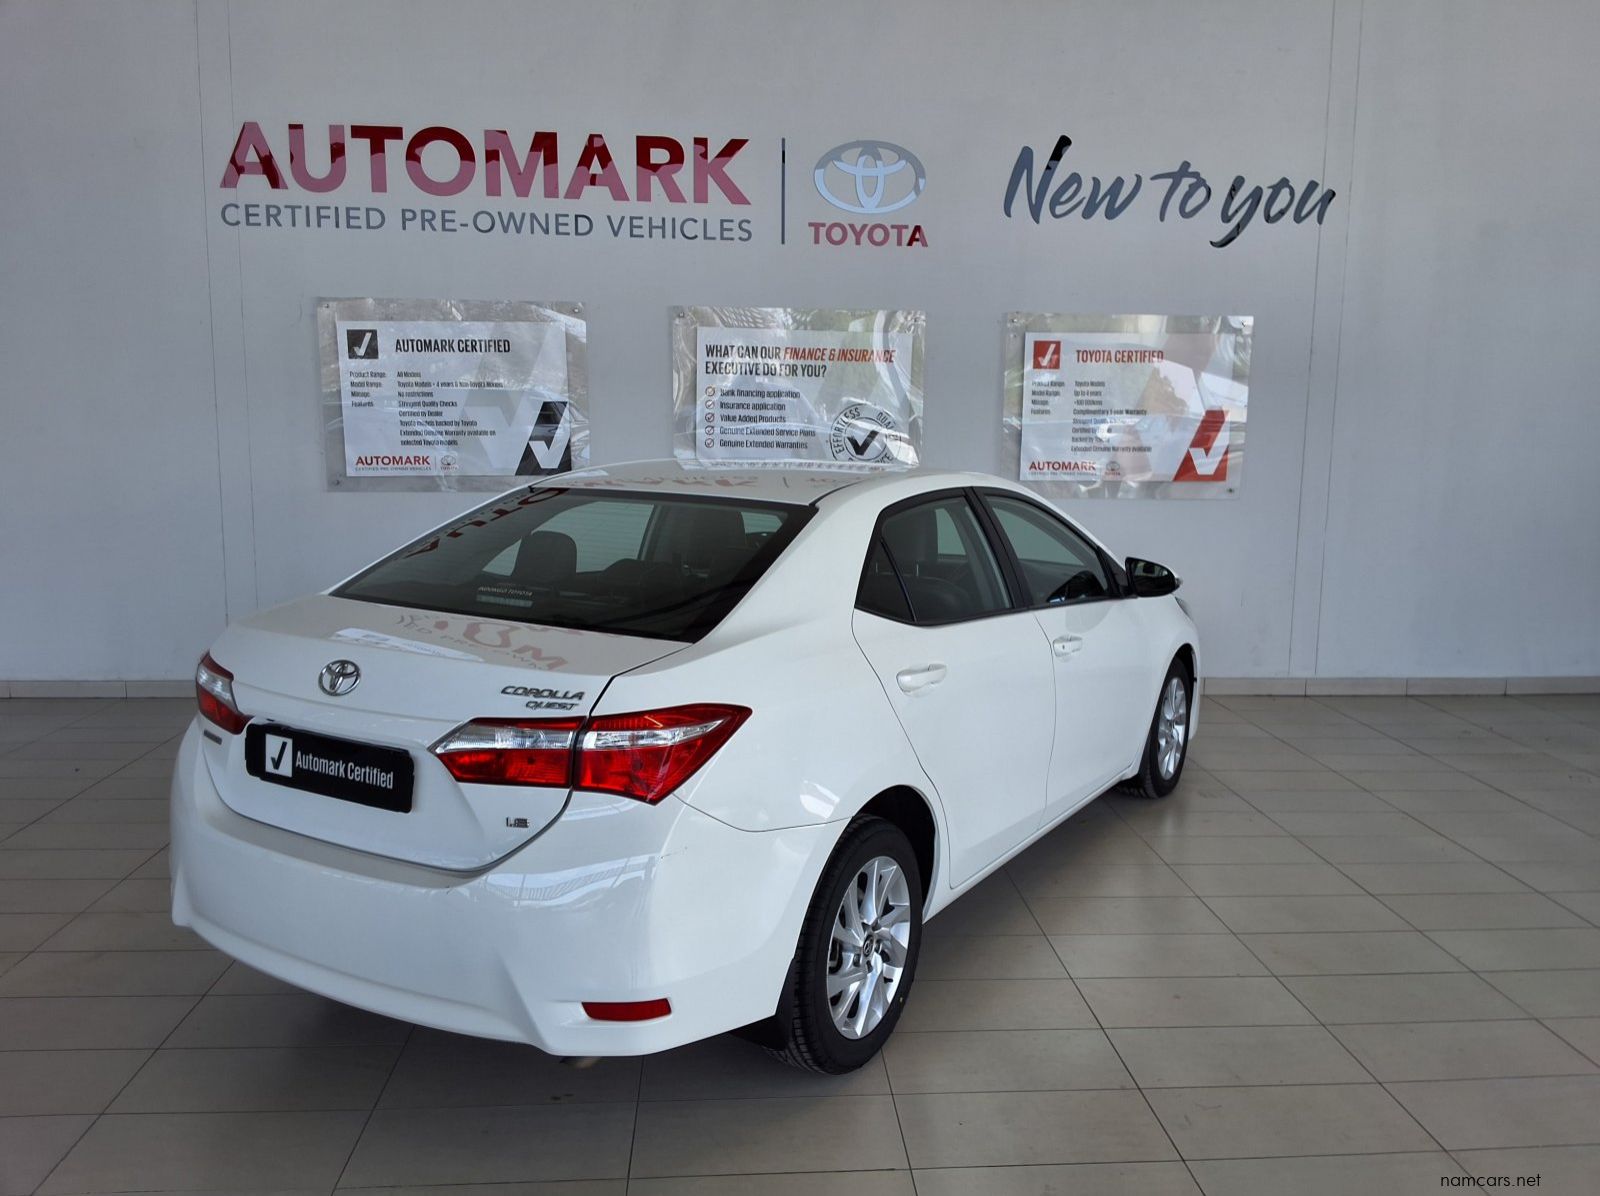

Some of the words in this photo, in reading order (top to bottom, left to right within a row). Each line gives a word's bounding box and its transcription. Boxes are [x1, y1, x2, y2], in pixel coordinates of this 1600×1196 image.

[220, 122, 751, 205] AUTOMARK
[1004, 135, 1141, 224] New
[1151, 161, 1211, 223] to
[1210, 176, 1336, 248] you
[221, 203, 386, 230] CERTIFIED
[401, 210, 593, 236] PRE-OWNED
[606, 215, 752, 241] VEHICLES
[808, 222, 928, 247] TOYOTA
[395, 339, 454, 353] AUTOMARK
[458, 339, 510, 353] CERTIFIED
[706, 344, 735, 358] WHAT
[737, 346, 758, 359] CAN
[760, 346, 781, 360] OUR
[784, 347, 827, 361] FINANCE
[837, 348, 896, 363] INSURANCE
[1076, 350, 1112, 363] TOYOTA
[1114, 350, 1164, 364] CERTIFIED
[706, 362, 760, 376] EXECUTIVE
[762, 362, 777, 376] DO
[779, 363, 798, 377] FOR
[800, 364, 827, 378] YOU?
[736, 388, 766, 398] financing
[766, 390, 800, 398] application
[720, 402, 750, 410] Insurance
[752, 402, 786, 411] application
[738, 414, 758, 422] Added
[720, 427, 744, 435] Genuine
[746, 427, 774, 436] Extended
[776, 428, 800, 436] Service
[832, 406, 860, 454] EFFORTLESS
[720, 440, 744, 448] Genuine
[746, 440, 774, 448] Extended
[776, 441, 808, 449] Warranties
[356, 456, 430, 466] AUTOMARK
[1029, 461, 1096, 470] AUTOMARK
[500, 686, 585, 700] COROLLA
[526, 701, 579, 710] QUEST
[296, 750, 346, 778] Automark
[348, 762, 394, 790] Certified
